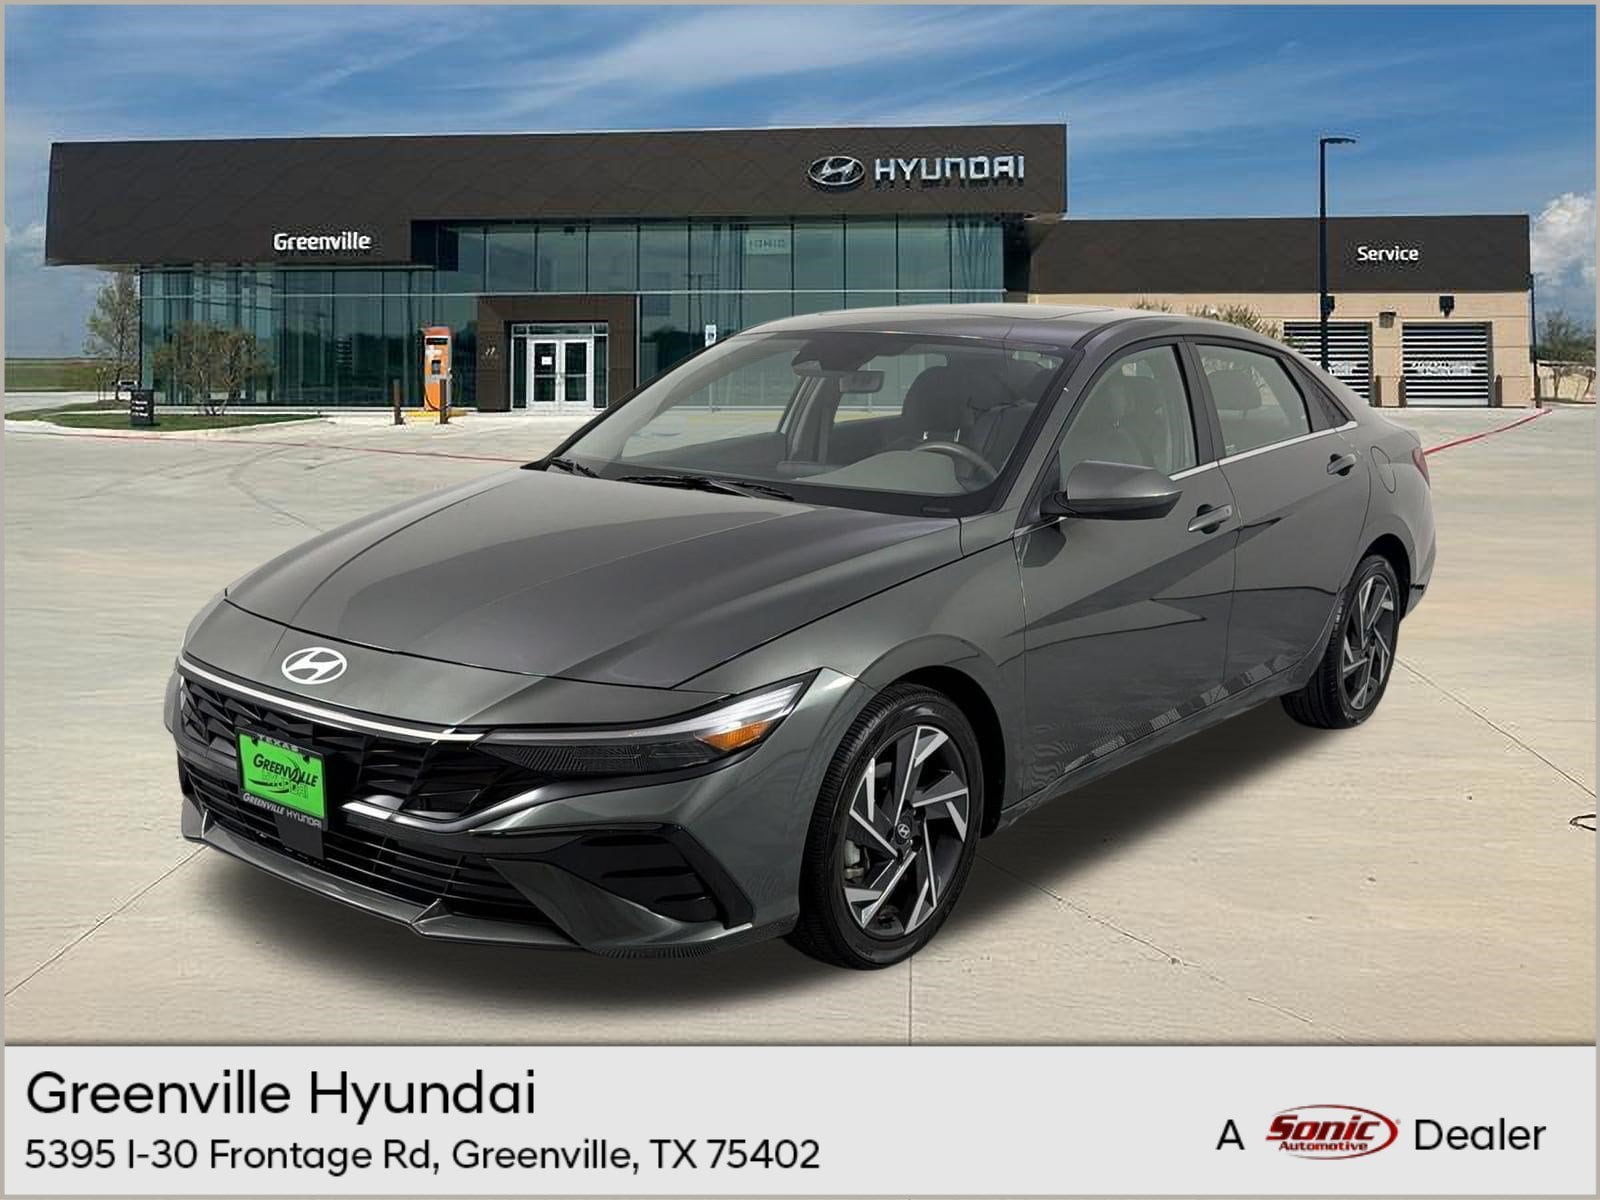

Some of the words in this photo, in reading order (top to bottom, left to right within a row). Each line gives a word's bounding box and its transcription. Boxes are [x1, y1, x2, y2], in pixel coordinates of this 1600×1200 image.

[875, 156, 1025, 181] HYUNDAI
[273, 231, 372, 251] Greenville
[1357, 245, 1419, 261] Service
[253, 753, 318, 788] GREENVILLE
[243, 792, 285, 815] GREENVILLE
